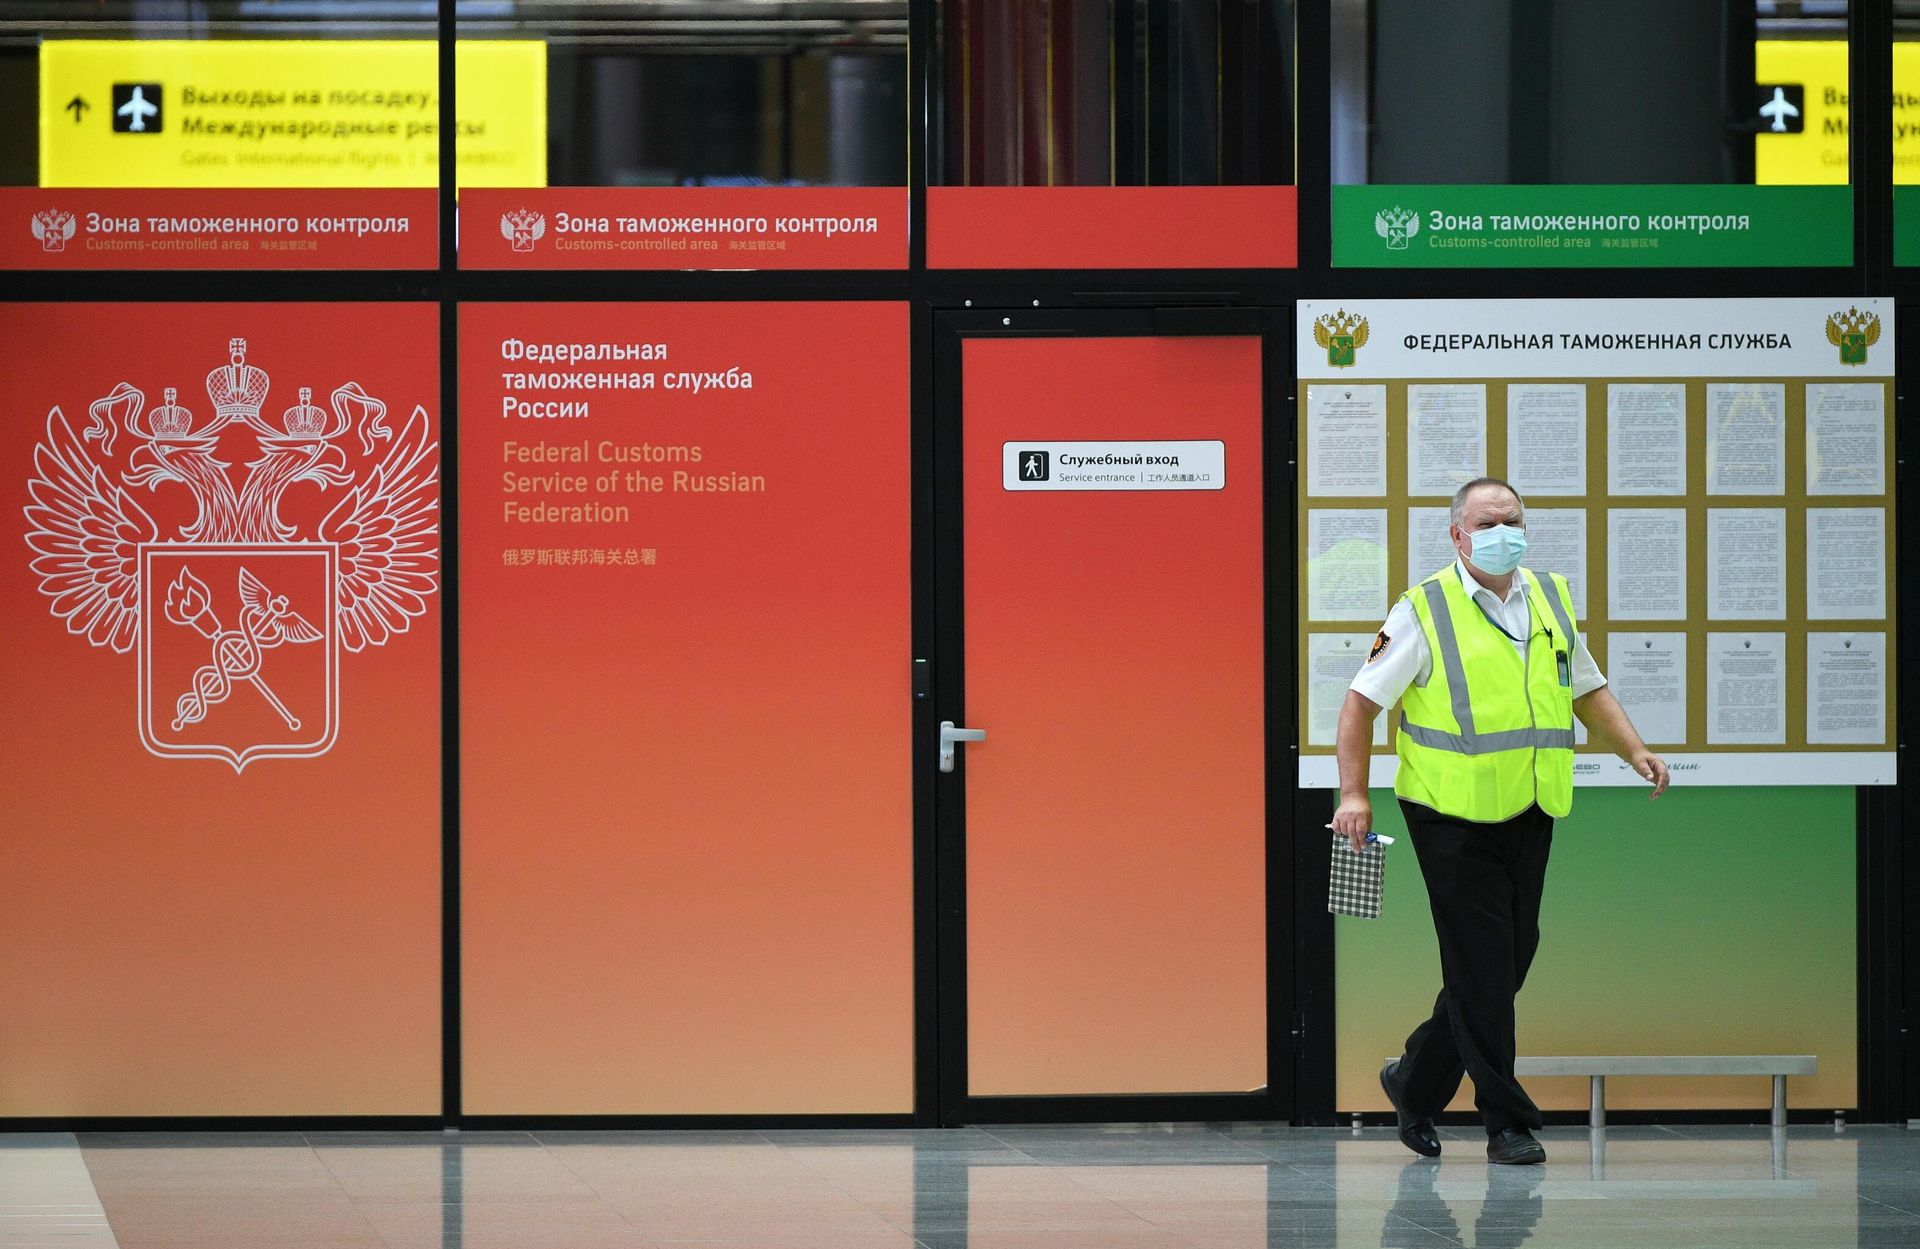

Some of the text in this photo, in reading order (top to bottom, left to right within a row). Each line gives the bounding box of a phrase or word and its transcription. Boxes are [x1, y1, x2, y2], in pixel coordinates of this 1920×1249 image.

[182, 86, 285, 109] Выходы
[293, 91, 321, 105] на
[182, 117, 486, 142] Международные ресы
[86, 212, 409, 238] Зона таможенного контроля
[555, 212, 878, 237] Зона таможенного контроля
[1429, 210, 1750, 235] Зона таможенного контроля
[86, 238, 249, 251] Customs-controlled area
[555, 237, 718, 250] Customs-controlled area
[1429, 235, 1591, 248] Customs-controlled area
[501, 338, 667, 365] Федеральная
[1403, 333, 1792, 352] ФЕДЕРАЛЬНАЯ ТАМОЖЕННАЯ СЛУЖБА
[502, 366, 753, 394] таможенная служба
[502, 396, 589, 418] России
[503, 440, 702, 463] Federal Customs
[1059, 453, 1179, 467] Служебный вход
[502, 470, 766, 493] Service of the Russian
[1059, 472, 1136, 482] Service entrance
[504, 501, 629, 523] Federation
[502, 548, 657, 566] 俄罗斯联邦海关总署
